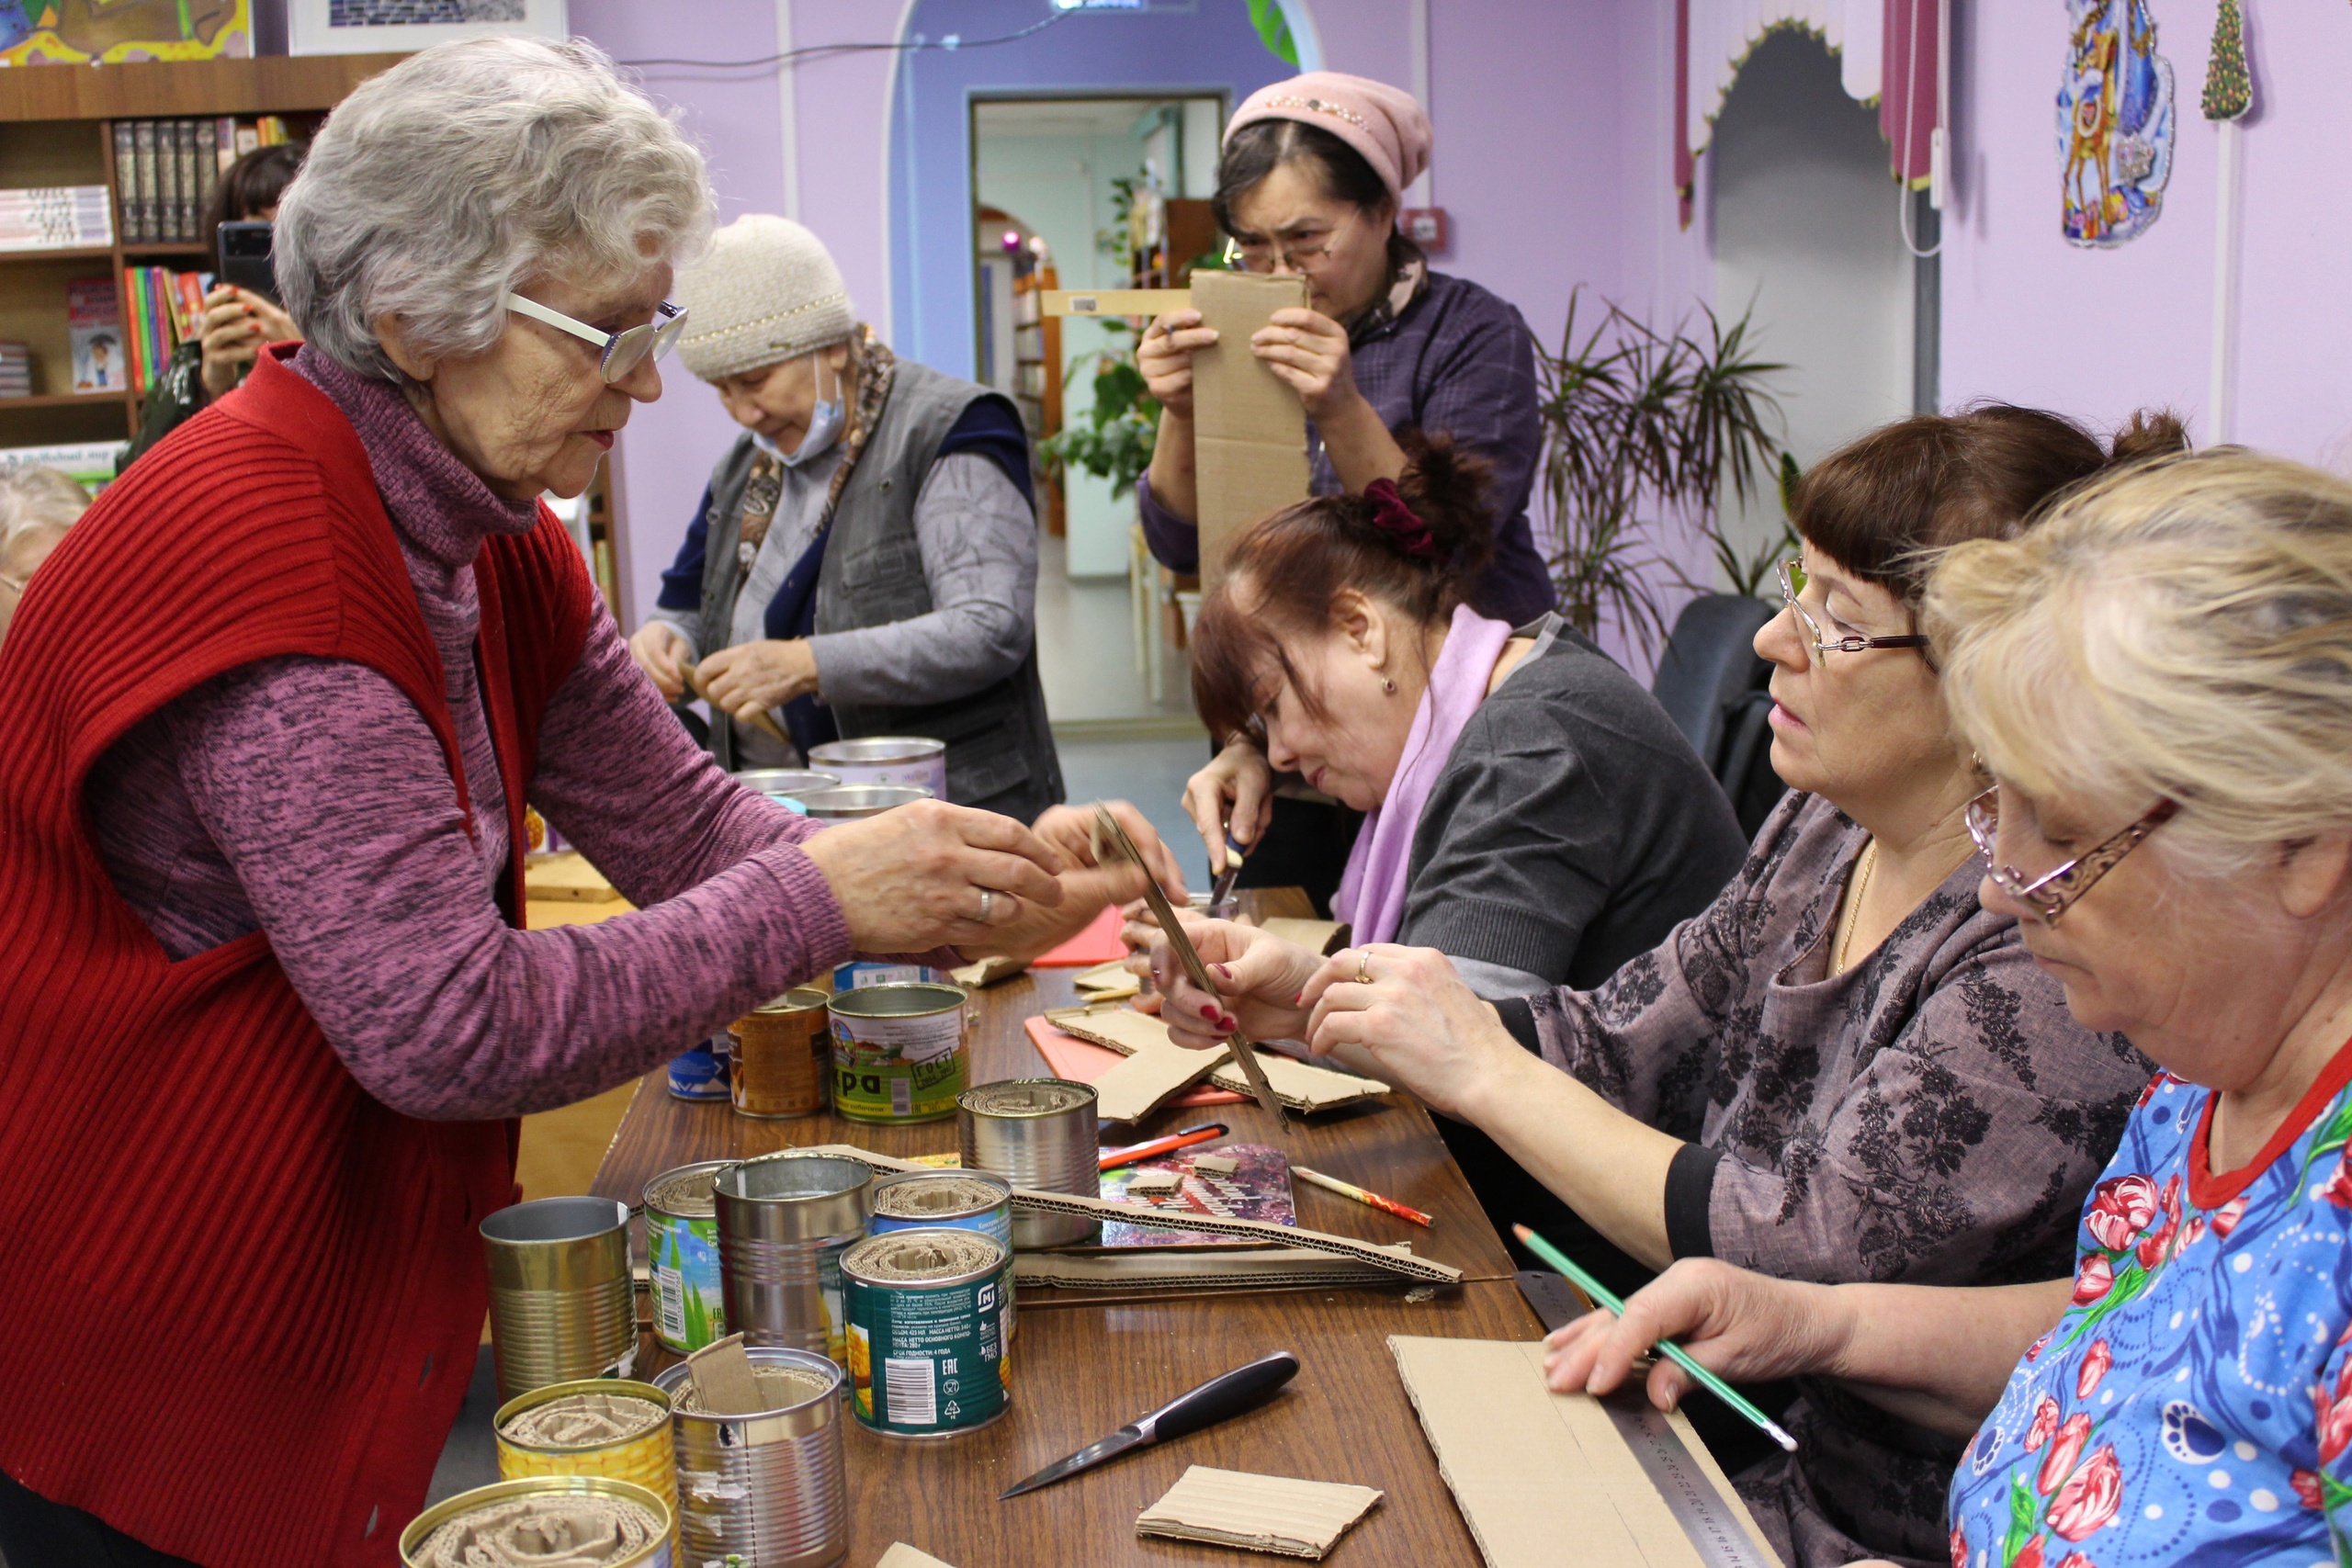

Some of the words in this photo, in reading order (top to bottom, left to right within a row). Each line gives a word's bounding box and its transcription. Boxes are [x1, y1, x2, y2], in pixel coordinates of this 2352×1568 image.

[916, 1053, 949, 1077] ГОСТ
[925, 1335, 954, 1343] ОСНОВНОГО
[986, 1342, 997, 1353] БЕЗ
[984, 1351, 998, 1362] ГМО
